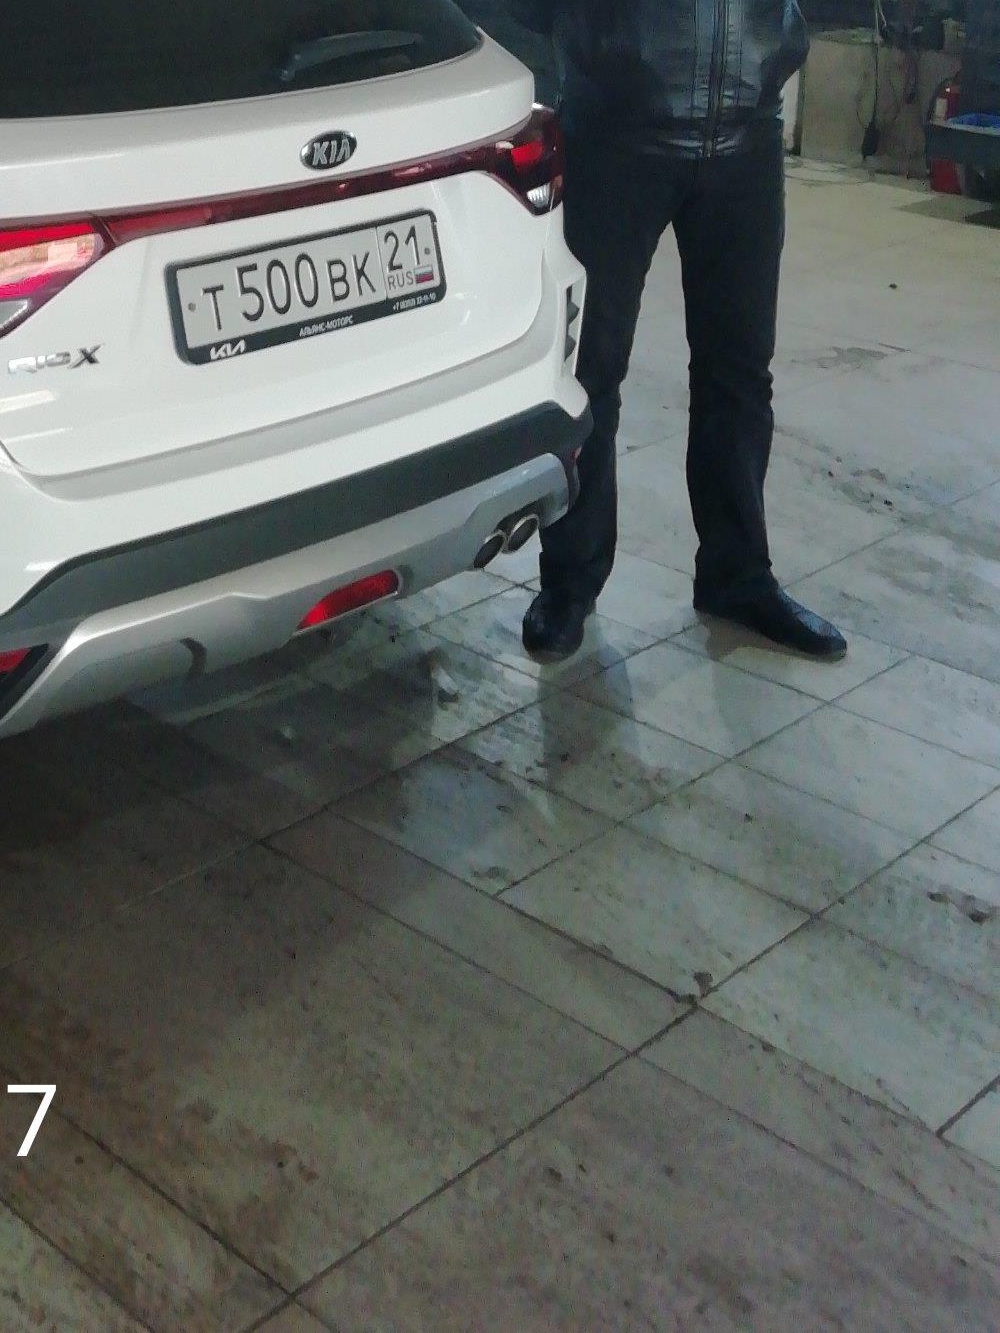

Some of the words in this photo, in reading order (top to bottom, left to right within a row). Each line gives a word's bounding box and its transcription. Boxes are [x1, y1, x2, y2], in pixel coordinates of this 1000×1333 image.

[312, 138, 351, 166] KIA
[384, 226, 421, 272] 21
[387, 270, 414, 290] RUS
[210, 339, 246, 360] KIA
